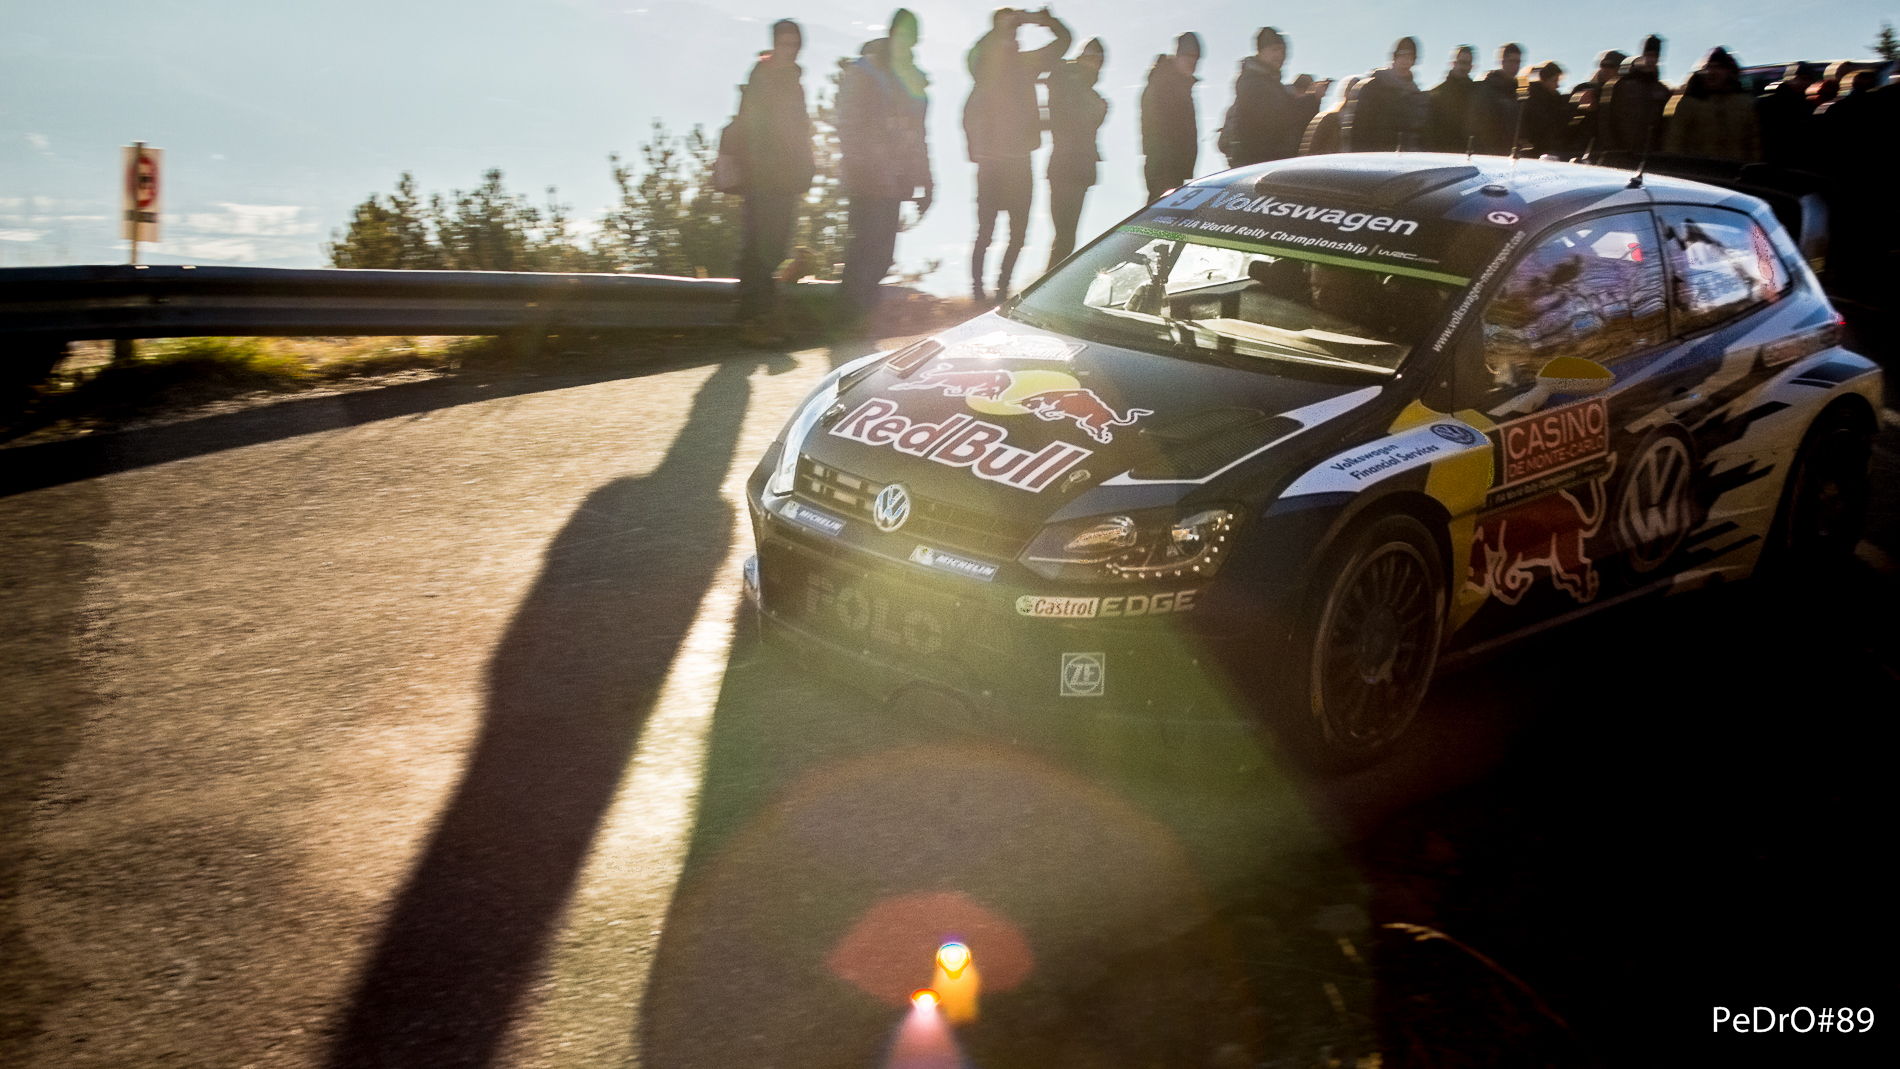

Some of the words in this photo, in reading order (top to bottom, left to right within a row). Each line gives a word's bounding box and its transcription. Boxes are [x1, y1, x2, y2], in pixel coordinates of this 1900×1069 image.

[1169, 188, 1204, 207] 9
[1210, 190, 1419, 236] Volkswagen
[1178, 218, 1201, 229] FIA
[1200, 221, 1237, 233] World
[1235, 225, 1269, 239] Rally
[1270, 231, 1368, 255] Championship
[829, 397, 973, 457] Red
[928, 420, 1094, 493] Bull
[1507, 403, 1604, 460] CASINO
[1330, 443, 1399, 471] Volkswagen
[1349, 455, 1402, 481] Financial
[1399, 443, 1440, 462] Services
[1508, 460, 1526, 478] DE
[799, 509, 843, 531] MICHELIN
[935, 554, 995, 576] MICHELIN
[806, 571, 943, 655] POLO
[1033, 599, 1095, 617] Castrol
[1100, 589, 1198, 618] EDGE
[1067, 662, 1099, 686] ZF
